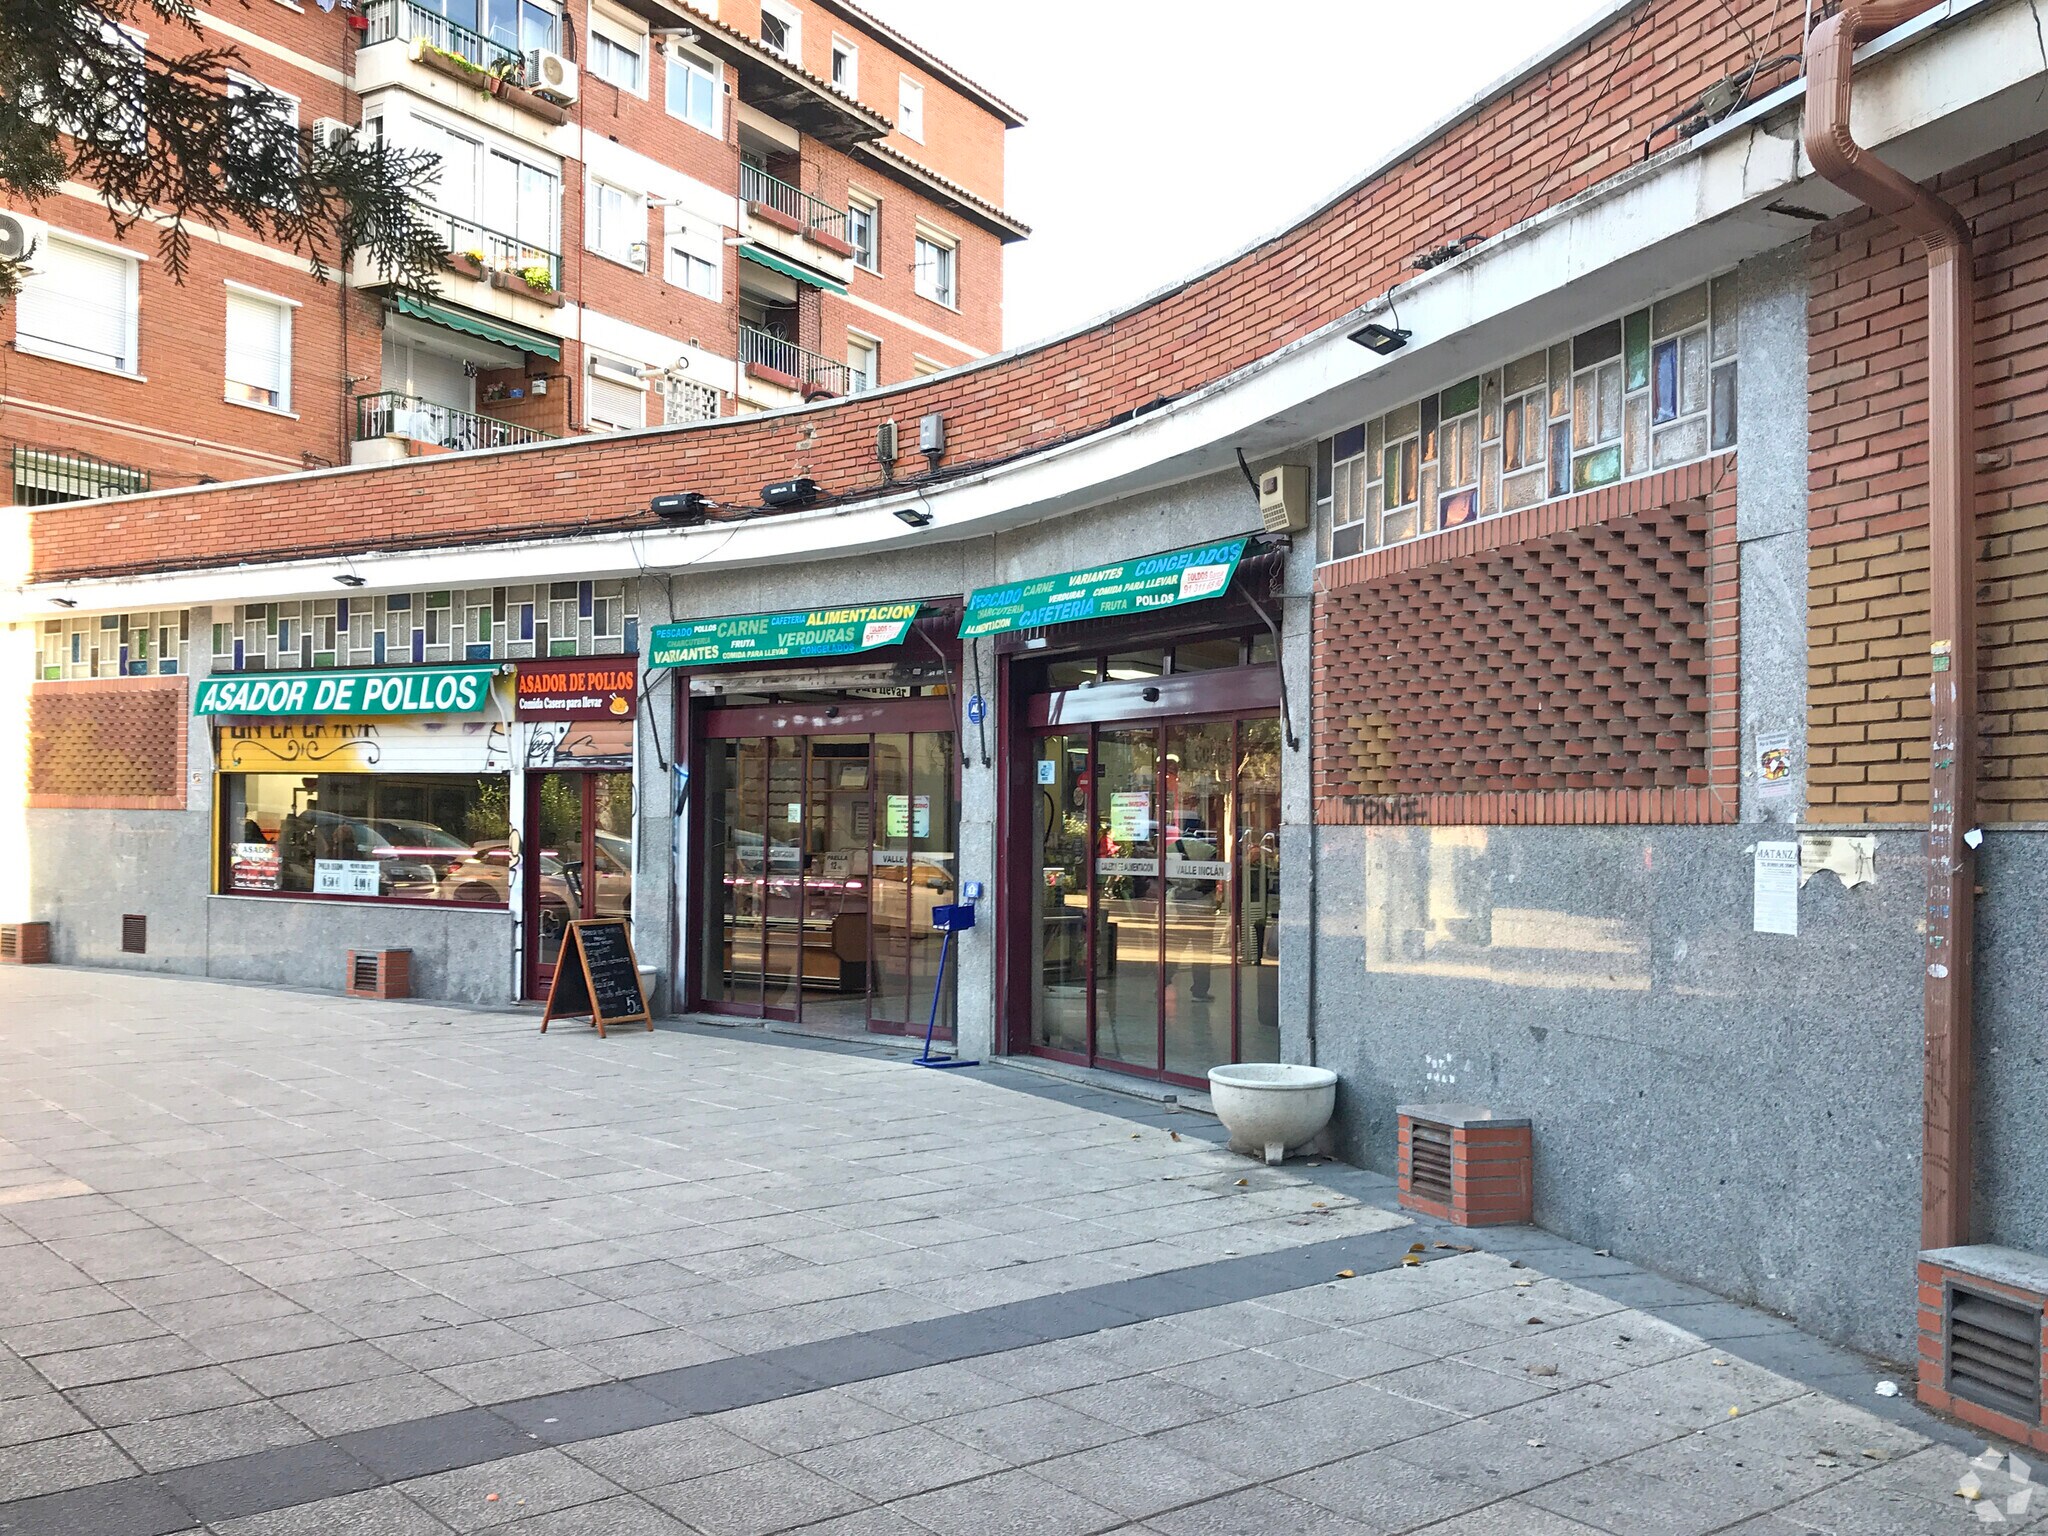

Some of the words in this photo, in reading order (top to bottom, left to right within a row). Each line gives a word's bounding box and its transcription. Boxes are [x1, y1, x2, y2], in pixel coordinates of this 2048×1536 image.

[1135, 542, 1242, 577] CONGELADOS
[1068, 567, 1124, 587] VARIANTES
[1187, 571, 1208, 582] TOLDOS
[1023, 581, 1055, 596] CARNE
[1093, 583, 1122, 597] COMIDA
[1124, 579, 1145, 593] PARA
[1146, 574, 1178, 589] LLEVAR
[970, 588, 1022, 611] PESCADO
[1049, 589, 1086, 603] VERDURAS
[1135, 593, 1174, 607] POLLOS
[977, 603, 1024, 620] CHARCUTERIA
[1019, 598, 1094, 626] CAFETERIA
[1100, 599, 1128, 612] FRUTA
[771, 614, 806, 626] CAFETERIA
[806, 604, 915, 626] ALIMENTACION
[656, 627, 693, 638] PESCADO
[694, 624, 717, 633] POLLOS
[717, 618, 769, 638] CARNE
[667, 637, 711, 648] CHARCUTERIA
[731, 638, 756, 649] FRUTA
[777, 627, 855, 647] VERDURAS
[653, 645, 719, 664] VARIANTES
[722, 650, 746, 660] COMIDA
[746, 649, 763, 658] PARA
[764, 648, 789, 657] LLEVAR
[800, 642, 855, 655] CONGELADOS
[519, 673, 567, 693] ASADOR
[569, 672, 587, 692] DE
[588, 671, 633, 691] POLLOS
[199, 680, 308, 713] ASADOR
[314, 678, 356, 711] DE
[362, 675, 480, 711] POLLOS
[519, 697, 543, 710] Comida
[544, 697, 566, 710] Casera
[566, 698, 582, 711] para
[582, 696, 603, 708] llevar
[243, 846, 275, 854] ASADOS
[883, 854, 905, 863] VALLE
[1177, 865, 1197, 876] VALLE
[1198, 864, 1225, 877] INCLÁN
